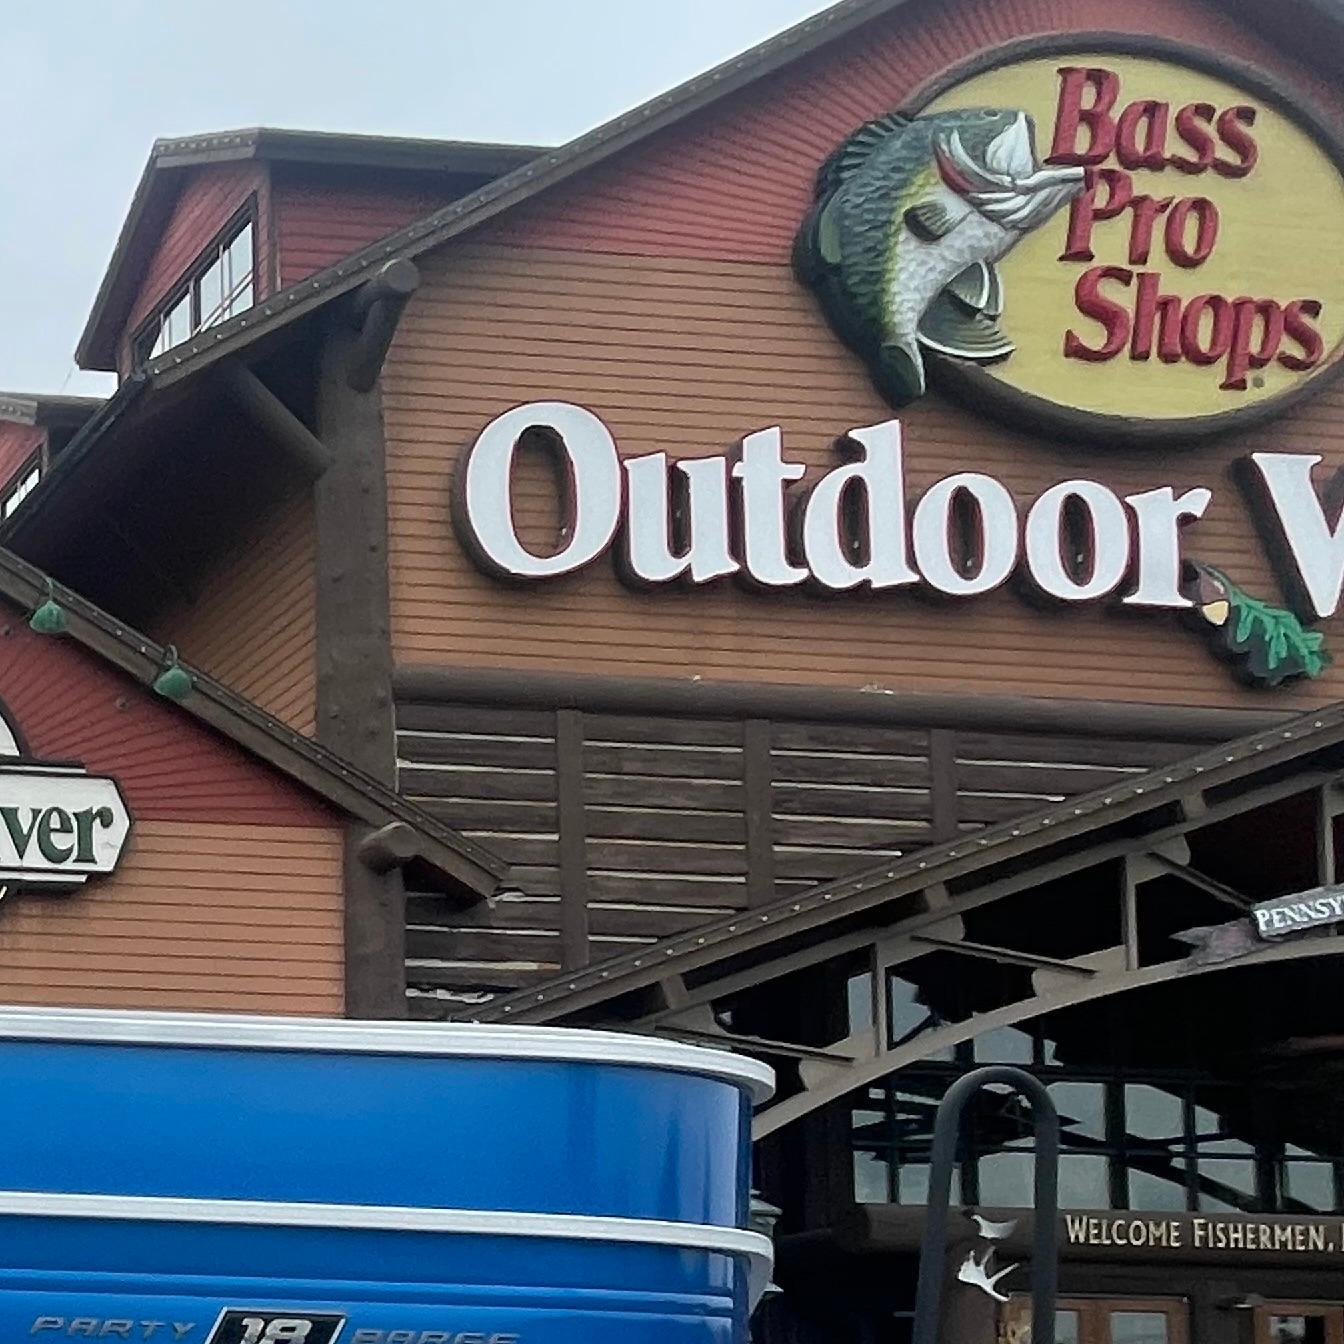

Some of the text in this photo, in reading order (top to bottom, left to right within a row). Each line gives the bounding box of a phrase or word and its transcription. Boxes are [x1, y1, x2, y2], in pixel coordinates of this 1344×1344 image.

[1043, 66, 1258, 179] Bass
[1057, 168, 1220, 269] Pro
[1064, 265, 1324, 391] Shops
[466, 401, 1212, 608] Outdoor
[1065, 1214, 1182, 1248] WELCOME
[1193, 1218, 1335, 1253] FISHERMEN,
[29, 1315, 197, 1340] PARTY
